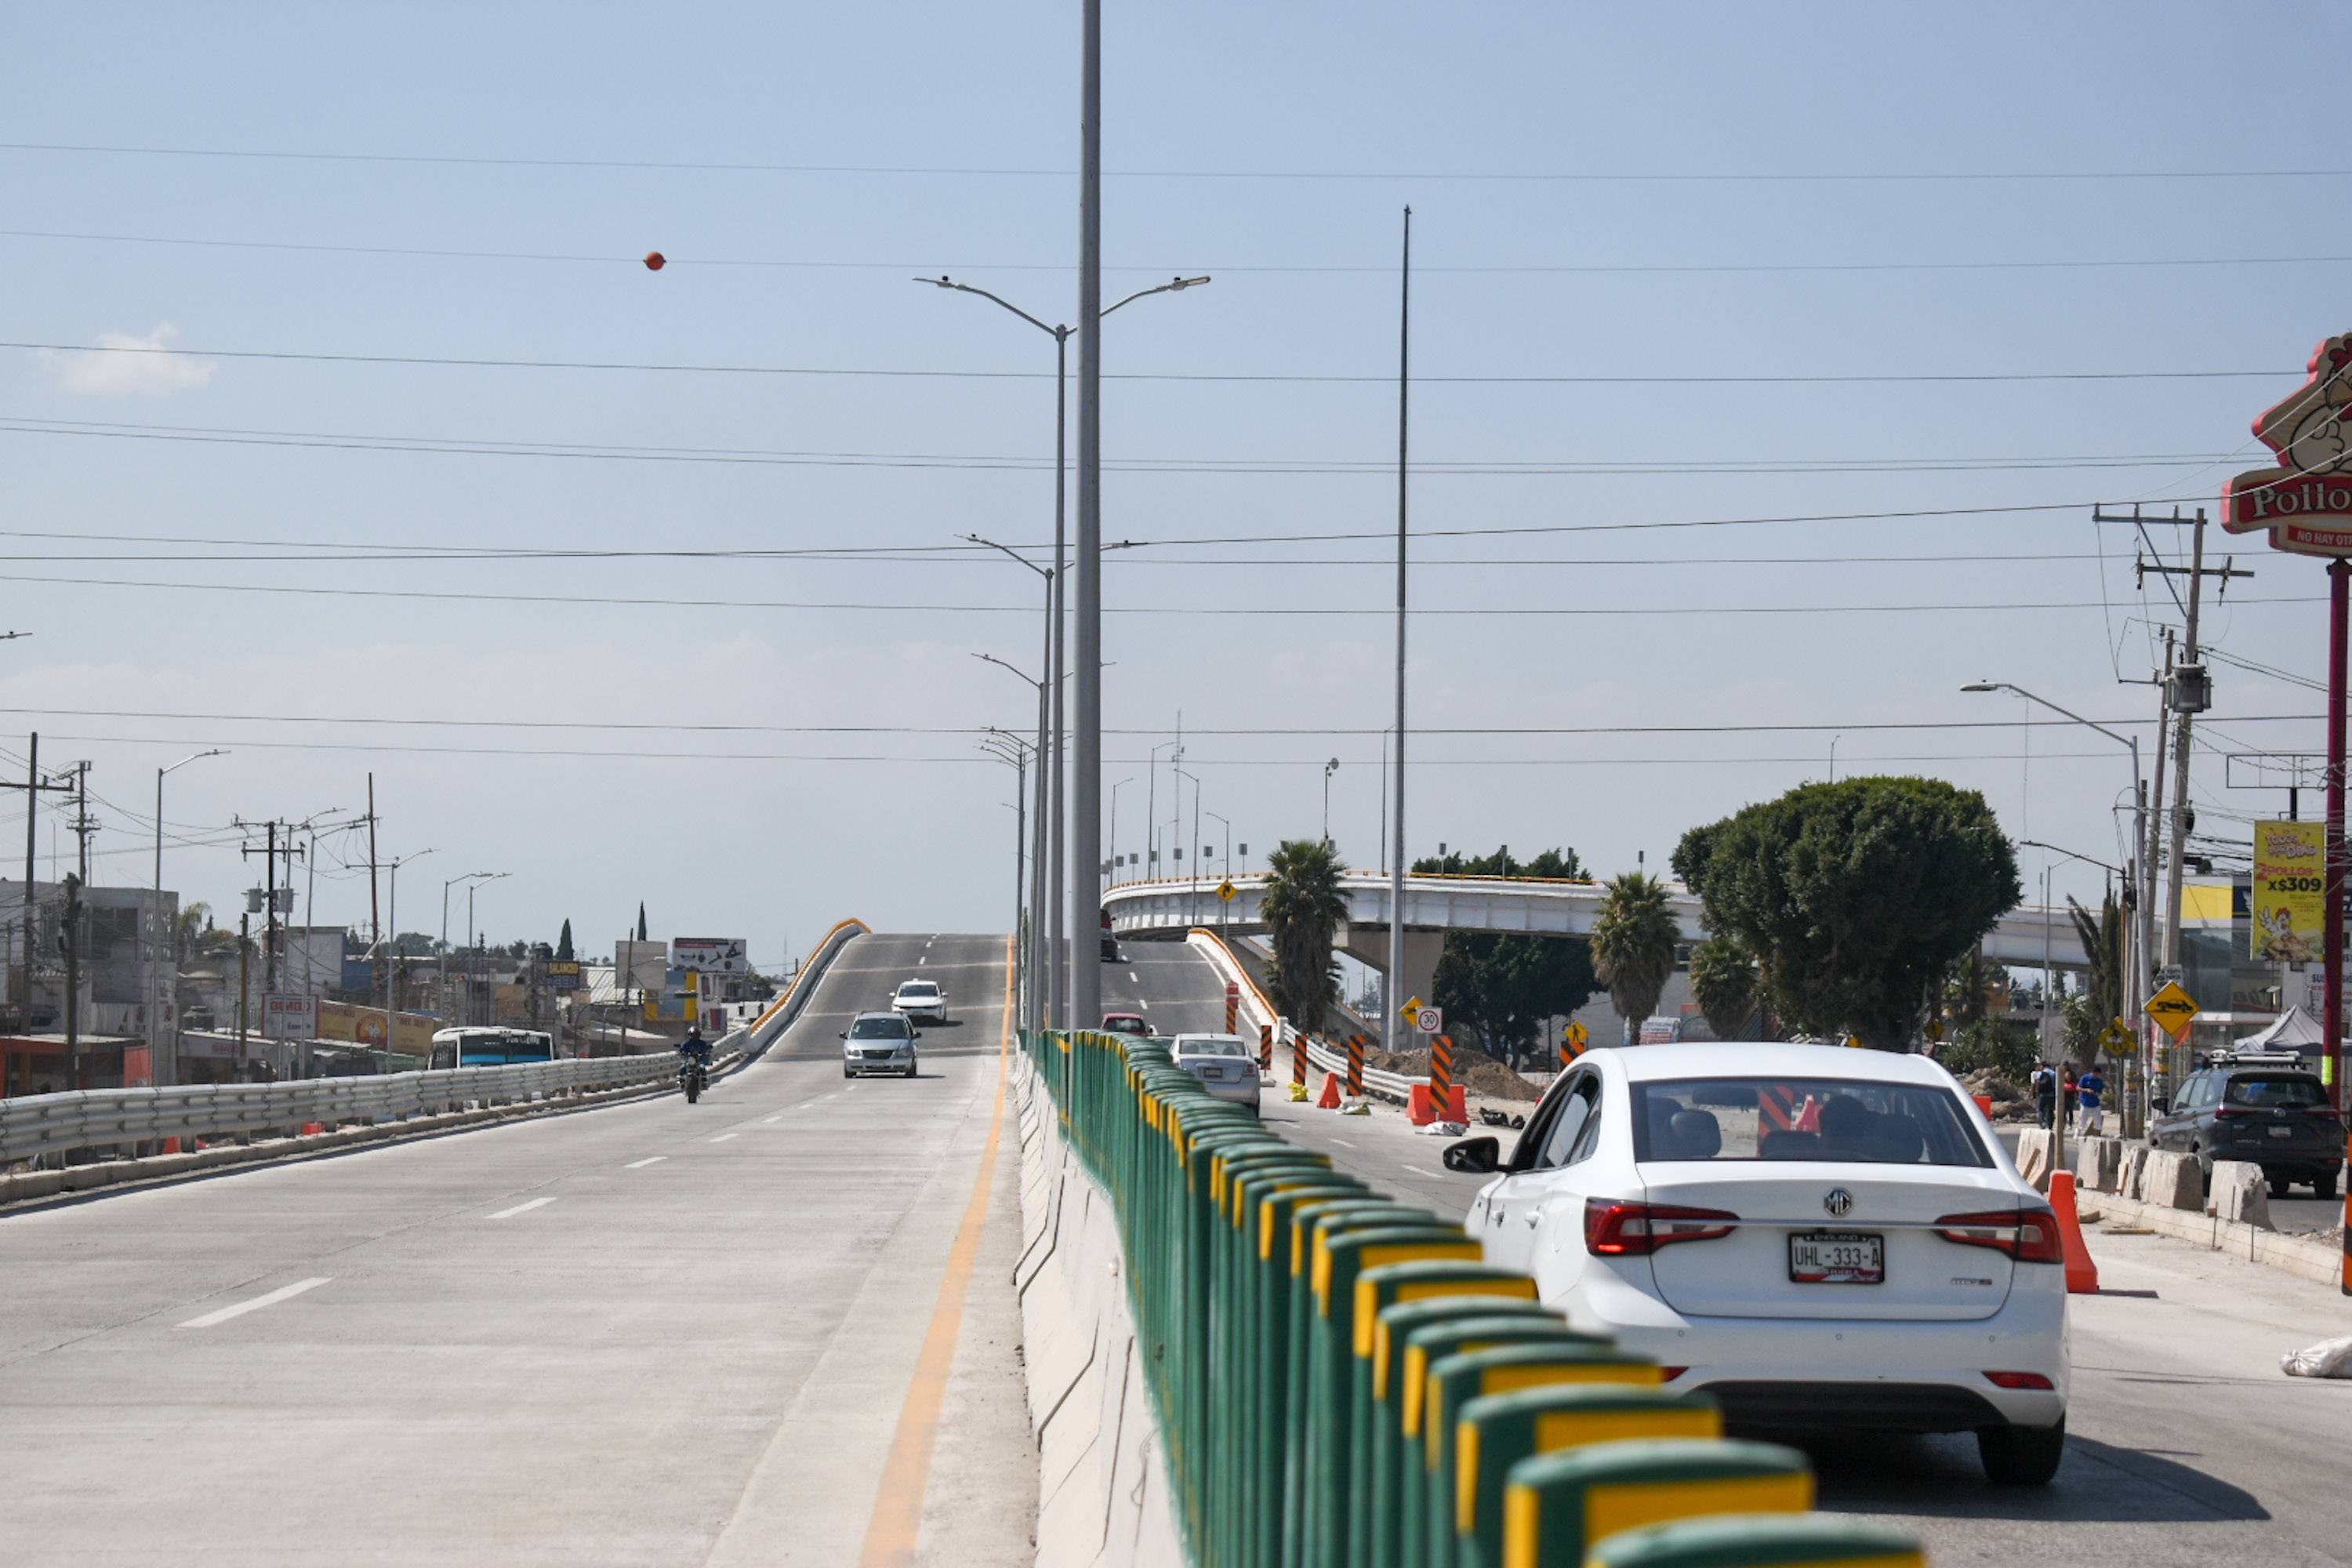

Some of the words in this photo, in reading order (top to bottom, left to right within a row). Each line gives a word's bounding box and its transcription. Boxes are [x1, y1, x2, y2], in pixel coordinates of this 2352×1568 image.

[2252, 482, 2351, 517] Pollo
[2297, 530, 2312, 542] NO
[2314, 532, 2335, 544] HAY
[2256, 863, 2268, 880] 2
[2267, 866, 2314, 877] POLLOS
[1424, 1014, 1435, 1024] 30
[1825, 1191, 1851, 1214] MG
[1795, 1246, 1880, 1267] UHL-333-A
